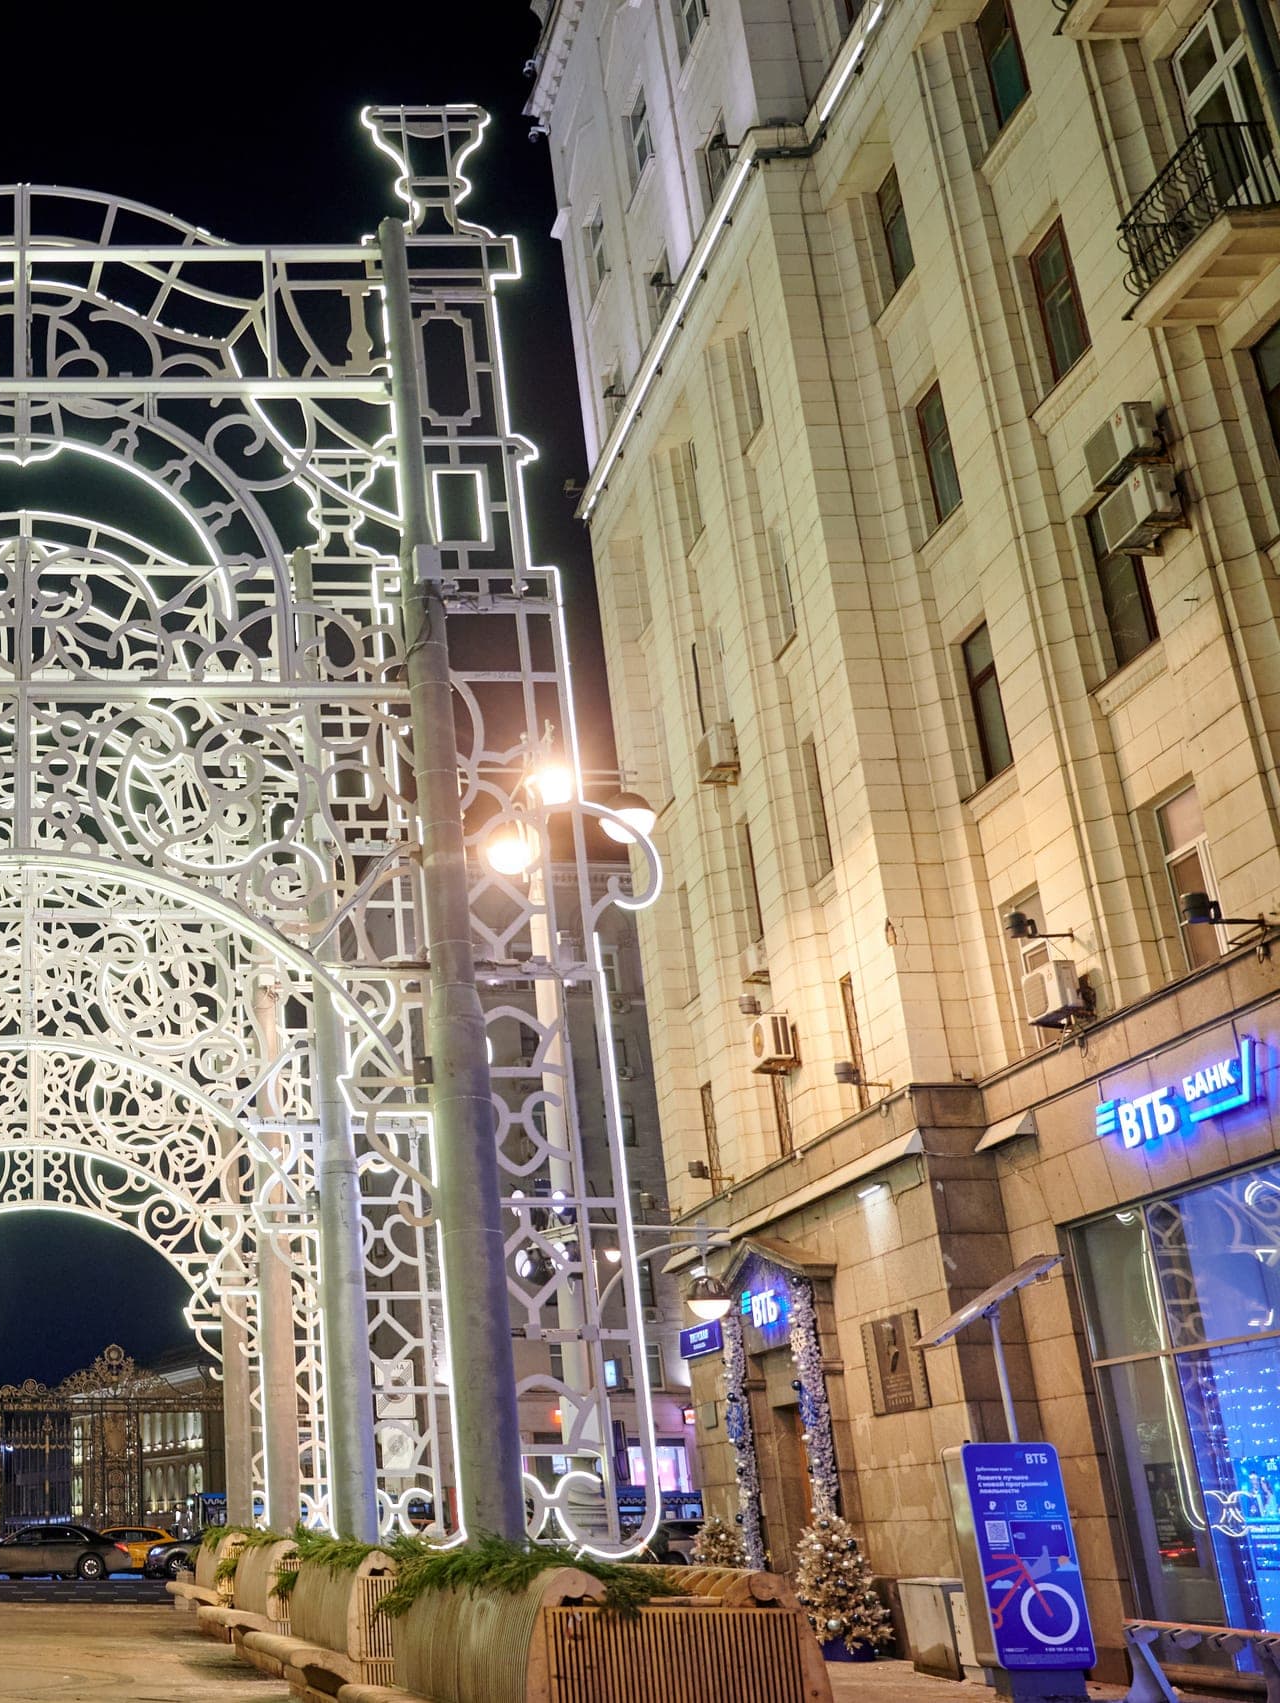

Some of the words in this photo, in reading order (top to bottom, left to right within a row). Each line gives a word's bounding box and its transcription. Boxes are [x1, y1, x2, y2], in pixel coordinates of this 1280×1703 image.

[1118, 1087, 1177, 1149] ВТБ
[1182, 1059, 1236, 1102] БАНК
[752, 1289, 778, 1328] ВТБ
[1025, 1453, 1048, 1464] ВТБ
